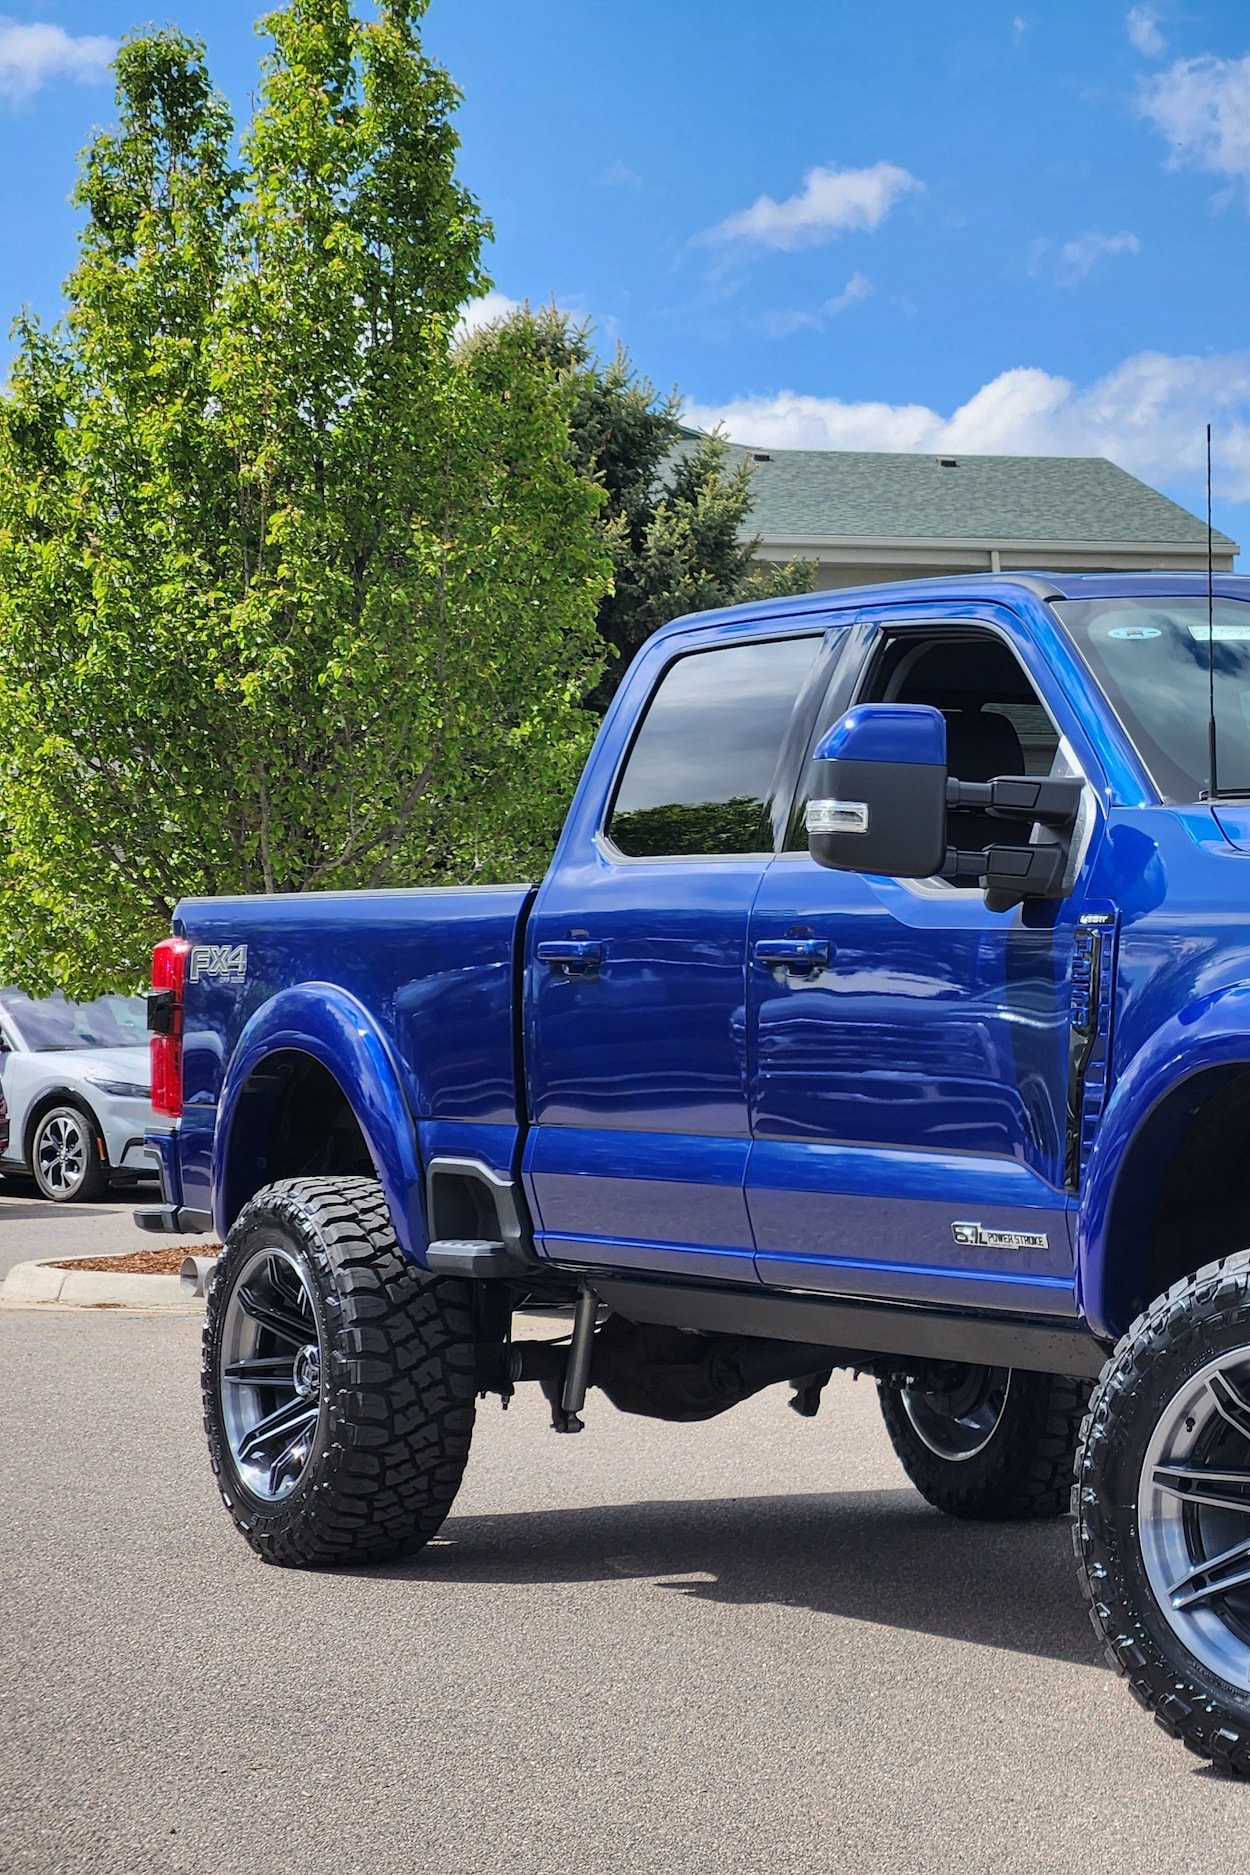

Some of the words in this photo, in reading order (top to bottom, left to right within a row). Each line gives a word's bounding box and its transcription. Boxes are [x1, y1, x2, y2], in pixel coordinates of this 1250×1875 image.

[189, 945, 248, 984] FX4
[987, 1232, 1014, 1244] POWER
[1014, 1234, 1045, 1247] STROKE
